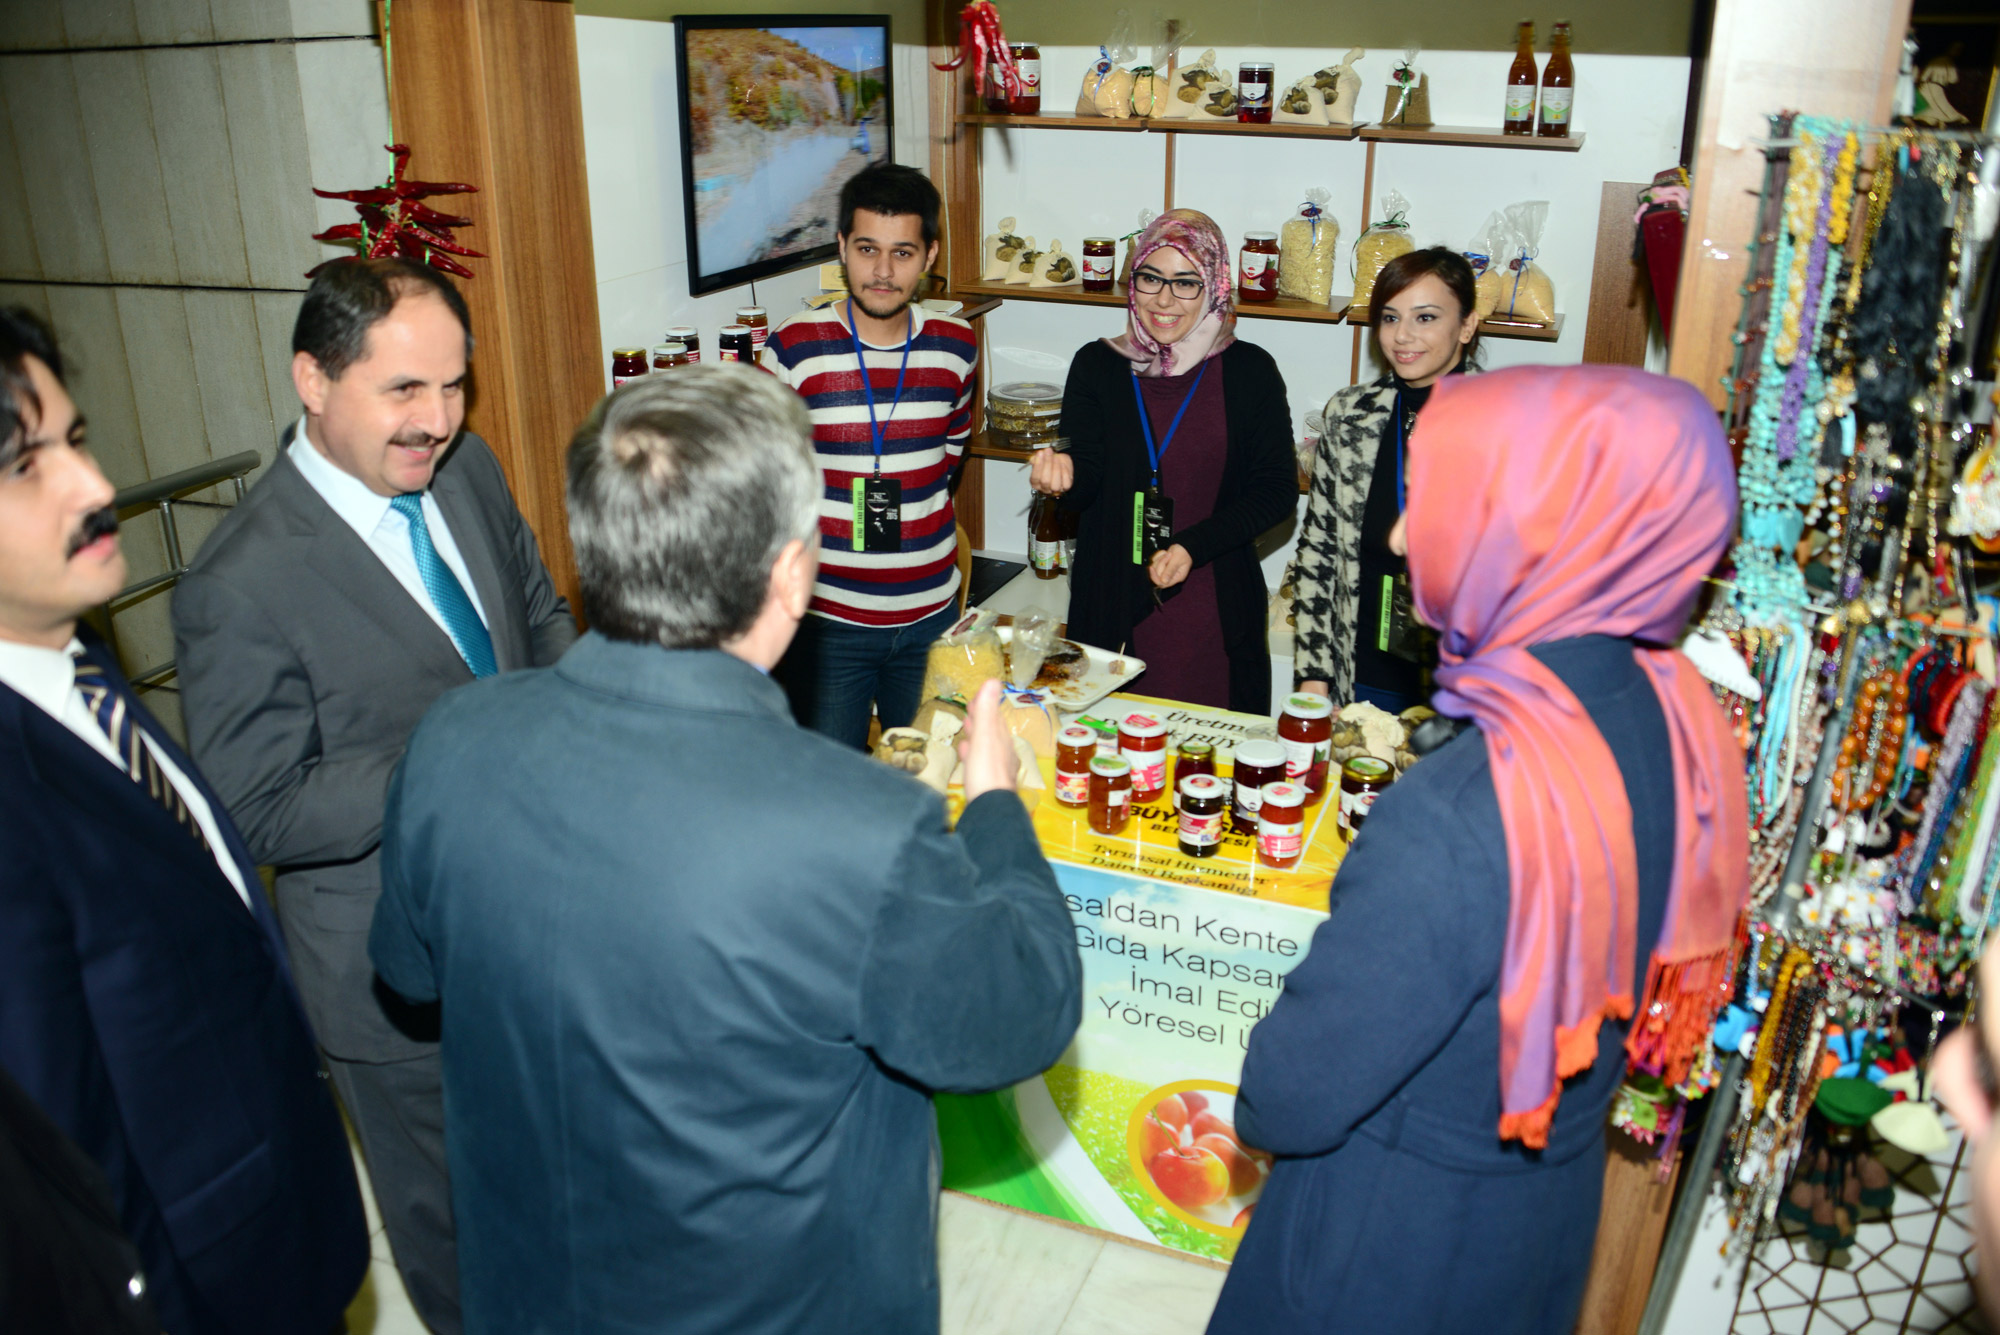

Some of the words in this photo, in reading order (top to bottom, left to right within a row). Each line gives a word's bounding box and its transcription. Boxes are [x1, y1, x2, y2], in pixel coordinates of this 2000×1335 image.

[1166, 711, 1247, 732] Üretm
[1175, 860, 1269, 885] Hizmetler
[1065, 893, 1180, 933] saldan
[1195, 915, 1298, 957] Kente
[1075, 924, 1148, 962] Gıda
[1131, 965, 1202, 1006] İmal
[1217, 989, 1269, 1020] Edi
[1098, 995, 1224, 1045] Yöresel
